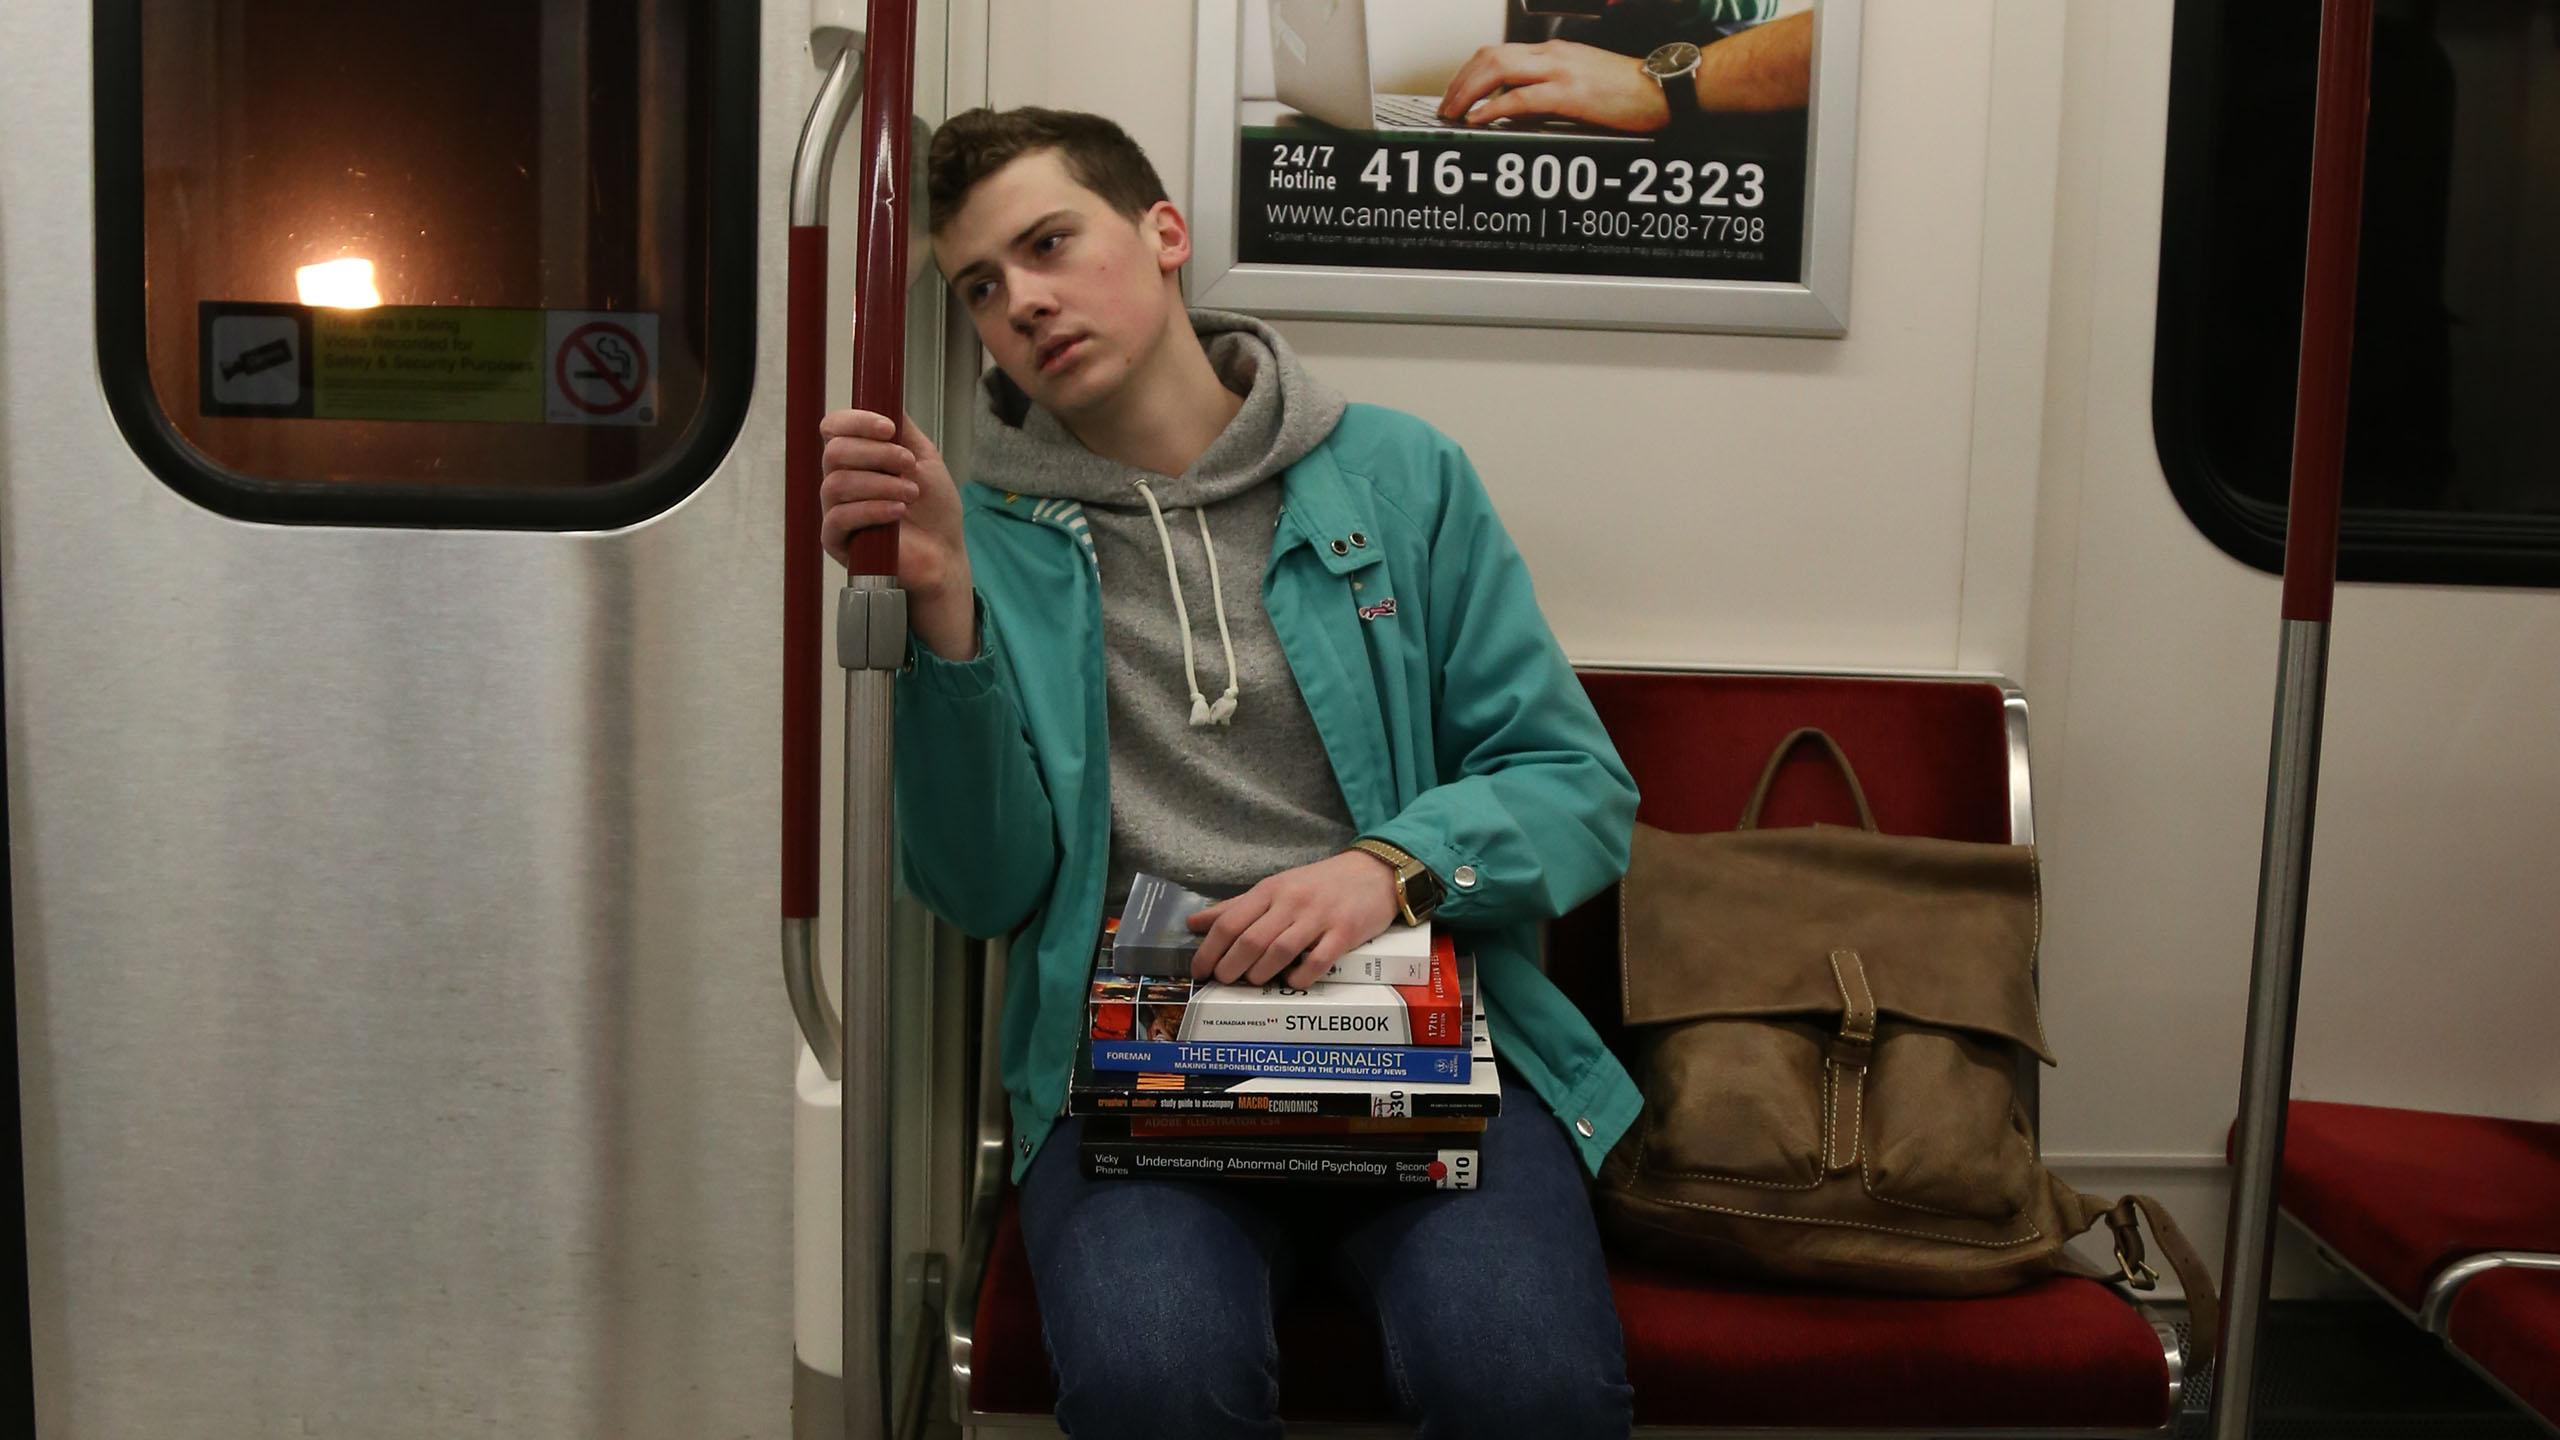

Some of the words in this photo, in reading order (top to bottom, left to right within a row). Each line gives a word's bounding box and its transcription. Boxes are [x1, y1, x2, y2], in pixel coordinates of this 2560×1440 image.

[1273, 144, 1335, 168] 24/7
[1270, 170, 1337, 190] Hotline
[1360, 148, 1765, 207] 416-800-2323
[1267, 203, 1531, 233] www.cannettel.com
[1558, 209, 1765, 243] 1-800-208-7798
[324, 354, 373, 372] Safety
[392, 355, 458, 375] Security
[1285, 1015, 1389, 1031] STYLEBOOK
[1428, 1012, 1438, 1037] 17th
[1106, 1052, 1151, 1061] FOREMAN
[1178, 1047, 1211, 1062] THE
[1216, 1048, 1289, 1064] ETHICAL
[1292, 1050, 1405, 1068] JOURNALIST
[1208, 1063, 1261, 1071] RESPONSIBLE
[1263, 1065, 1306, 1073] DECISIONS
[1335, 1067, 1370, 1075] PURSUIT
[1160, 1099, 1176, 1109] study
[1178, 1099, 1193, 1109] guide
[1195, 1099, 1201, 1108] to
[1202, 1100, 1234, 1109] accompany
[1144, 1117, 1183, 1128] ADOBE
[1187, 1117, 1257, 1127] ILLUSTRATOR
[1095, 1154, 1119, 1165] Vicky
[1136, 1155, 1224, 1170] Understanding
[1227, 1158, 1286, 1170] Abnormal
[1289, 1159, 1318, 1171] Child
[1321, 1160, 1387, 1175] Psychology
[1095, 1166, 1129, 1175] Phares
[1399, 1173, 1430, 1183] Edition
